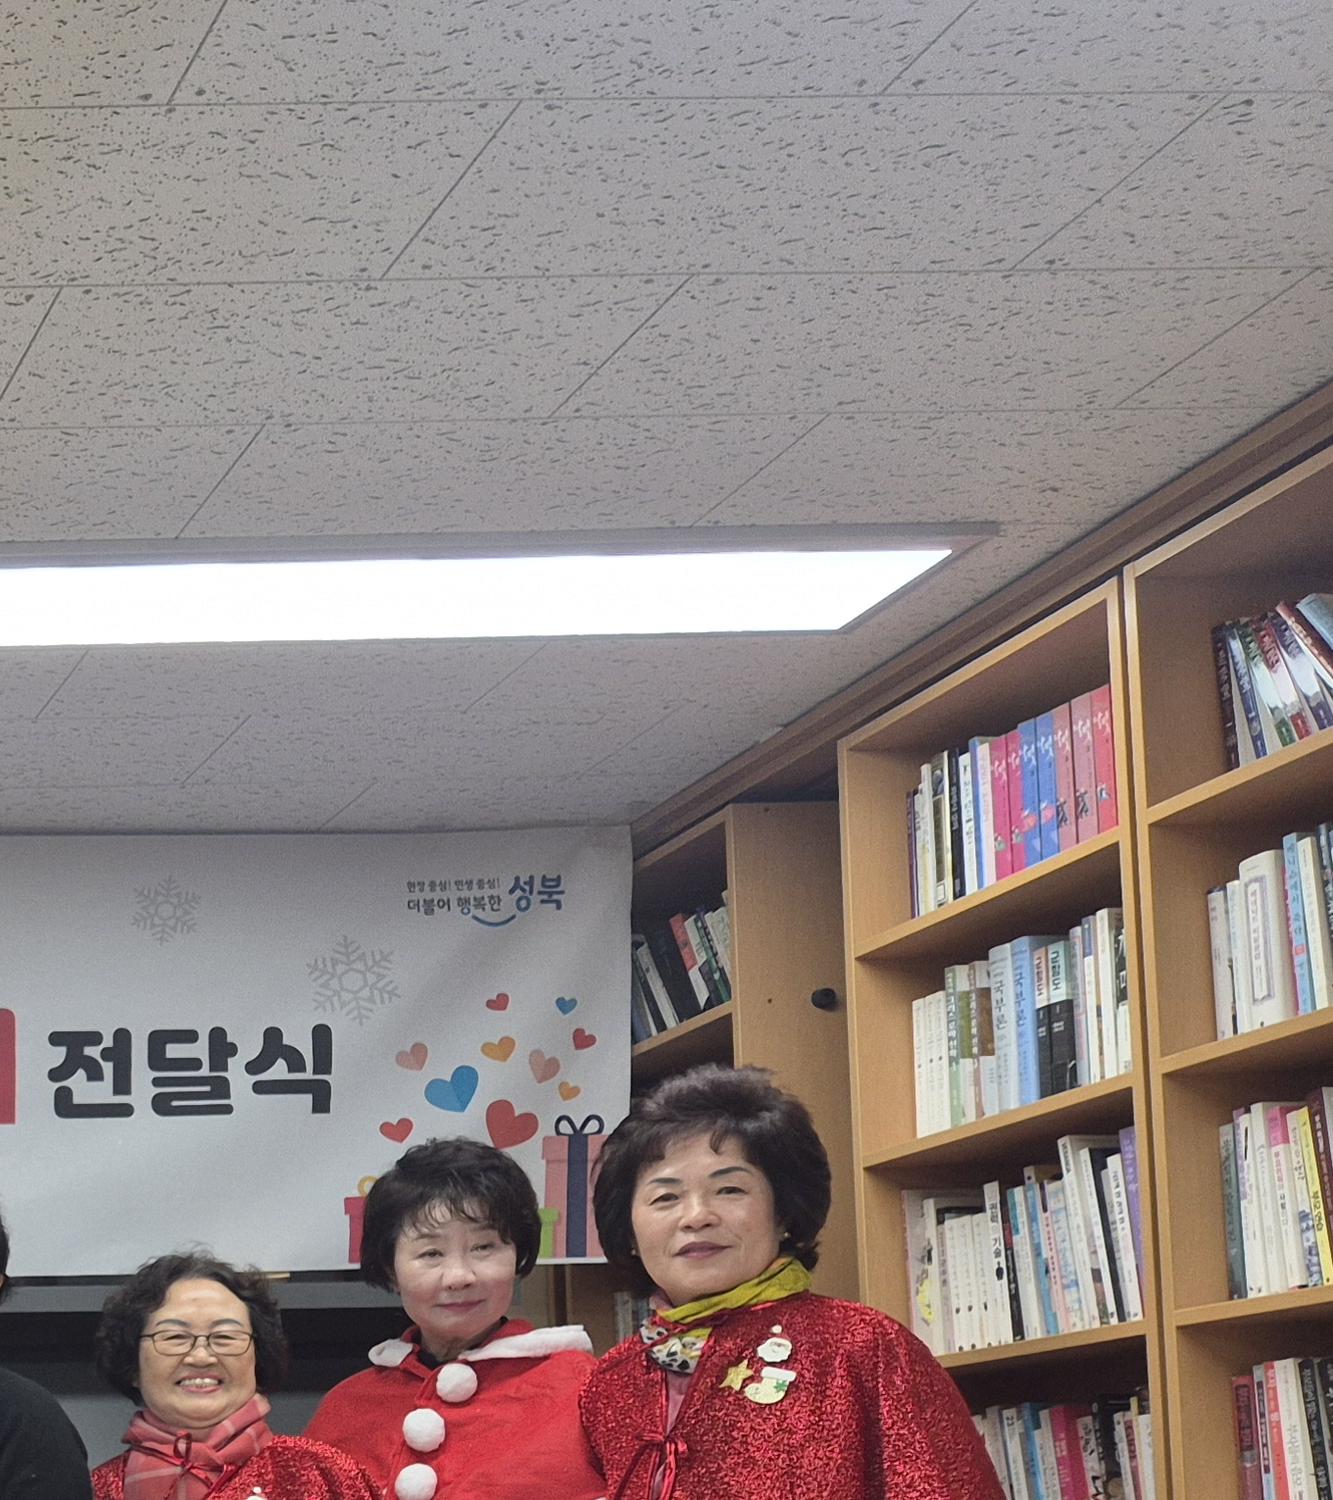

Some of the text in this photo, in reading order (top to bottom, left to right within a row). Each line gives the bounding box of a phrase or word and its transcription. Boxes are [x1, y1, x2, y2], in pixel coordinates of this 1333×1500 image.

[407, 874, 565, 916] 더불어 행복한 성북
[454, 879, 473, 892] 민생
[47, 1023, 333, 1118] 전달식
